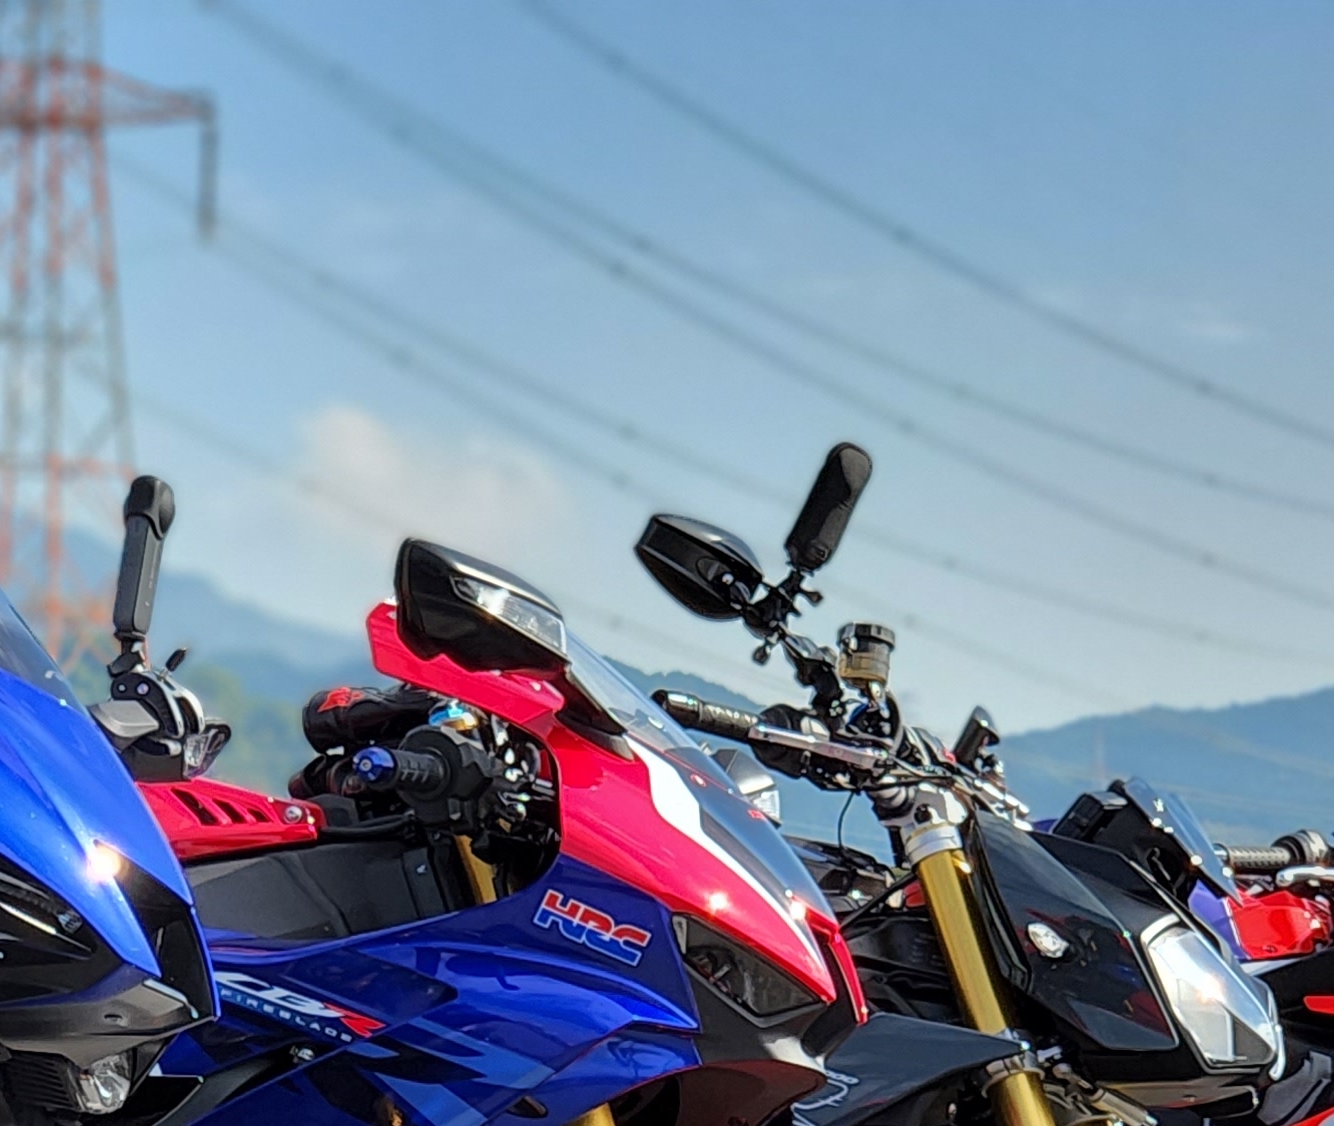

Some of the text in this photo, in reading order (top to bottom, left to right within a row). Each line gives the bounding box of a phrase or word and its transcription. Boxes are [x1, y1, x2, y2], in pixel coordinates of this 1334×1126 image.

[533, 889, 652, 967] HRC
[214, 971, 387, 1038] CBR
[219, 987, 354, 1043] FIREBLADE
